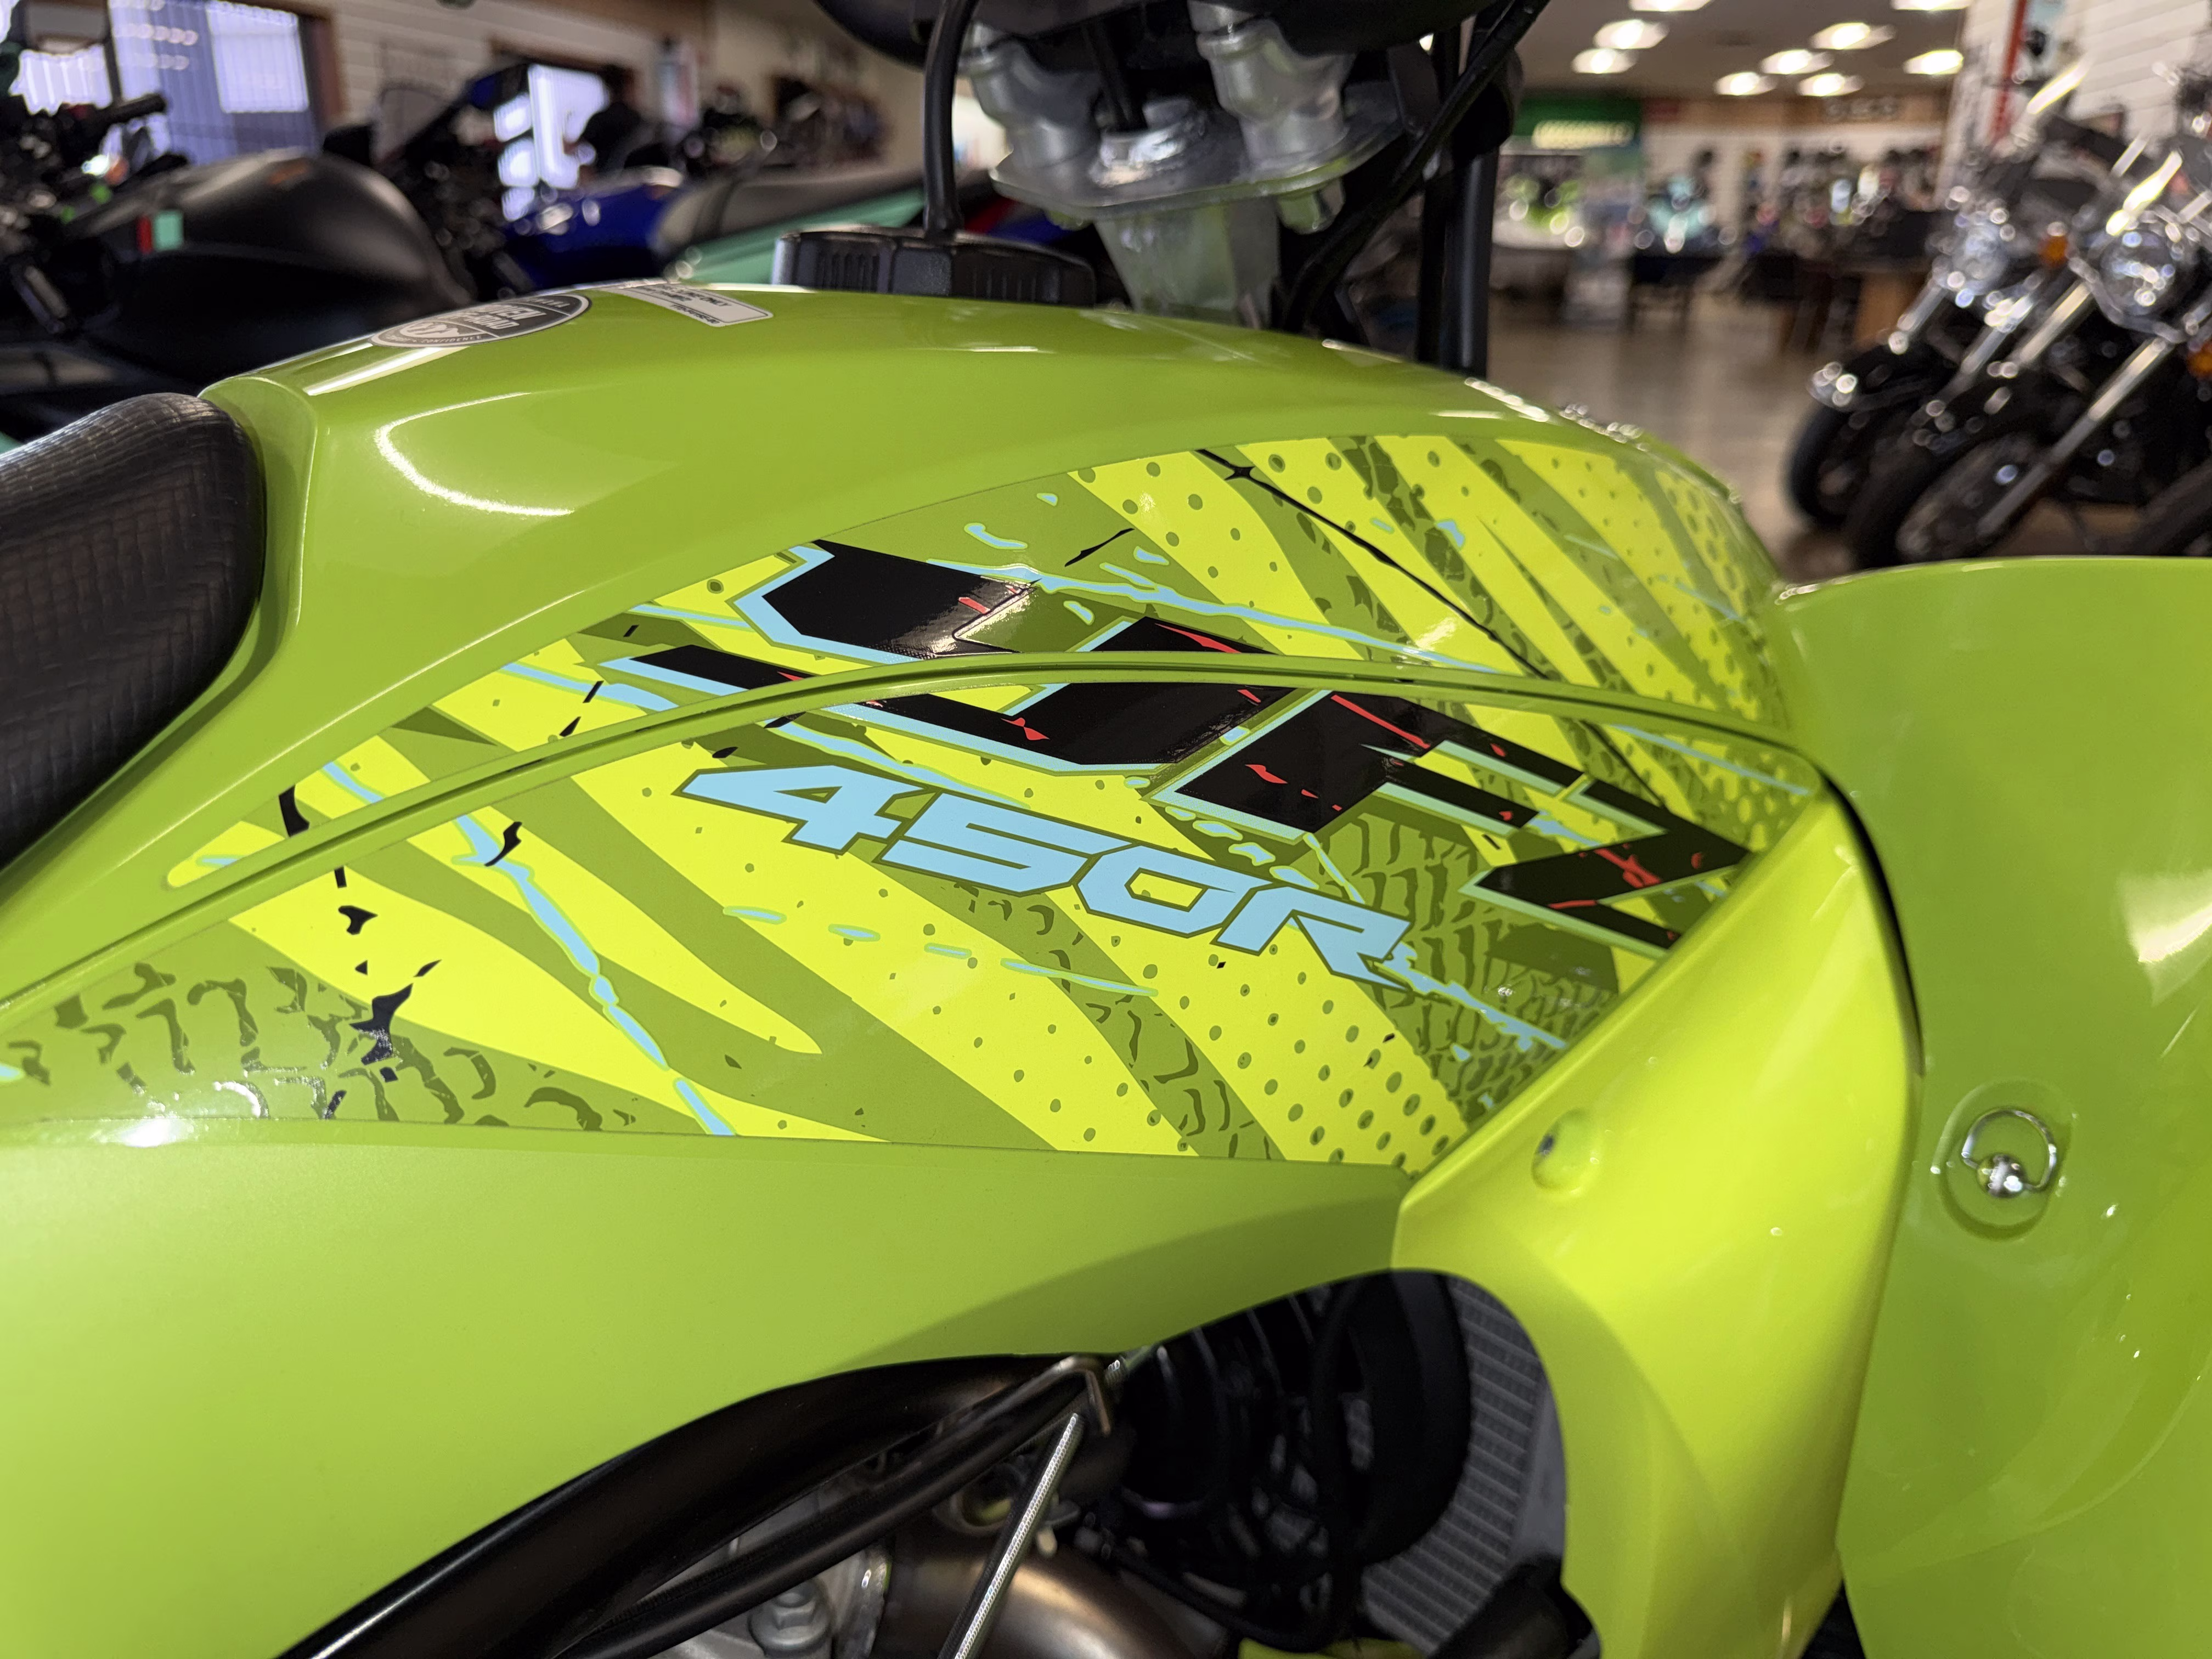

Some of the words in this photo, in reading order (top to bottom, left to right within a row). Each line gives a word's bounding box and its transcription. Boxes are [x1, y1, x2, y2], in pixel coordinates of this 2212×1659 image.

[523, 296, 571, 308] AMAHA
[420, 335, 483, 344] CONFIDENCE
[672, 764, 1412, 989] 450R
